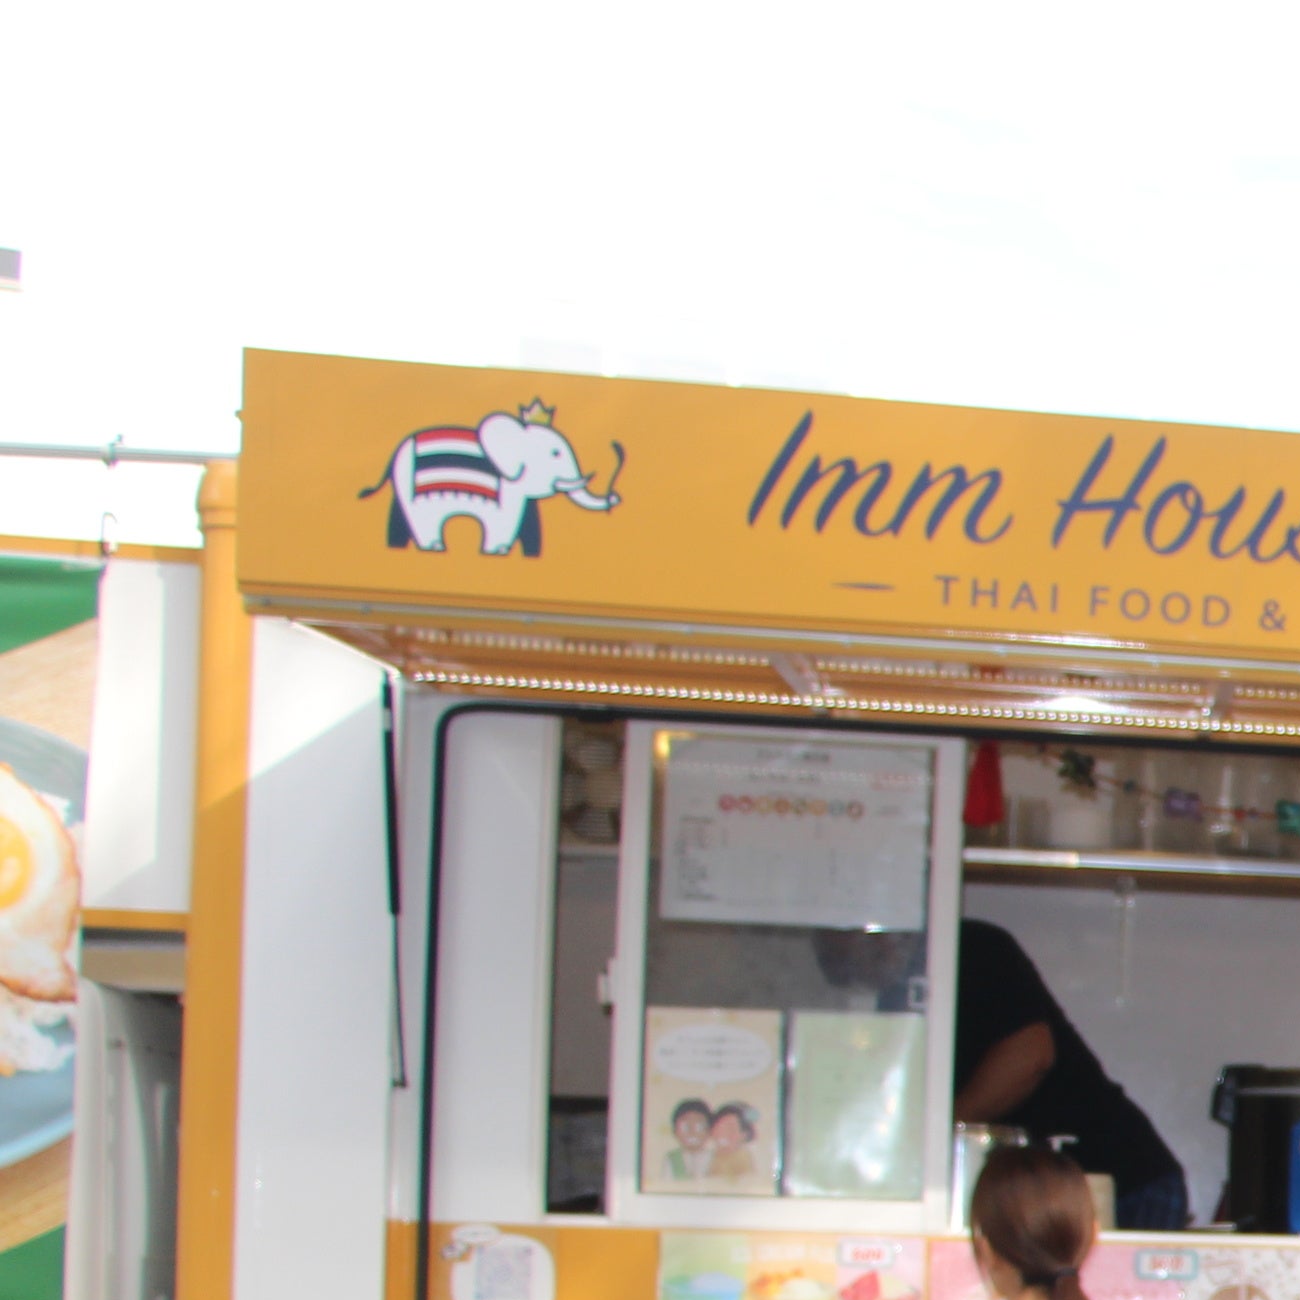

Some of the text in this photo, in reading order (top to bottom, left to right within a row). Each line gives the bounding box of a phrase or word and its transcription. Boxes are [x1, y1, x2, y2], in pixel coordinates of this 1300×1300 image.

[747, 410, 1013, 545] Imm
[934, 574, 1060, 613] THAI
[1089, 585, 1232, 628] FOOD
[1258, 599, 1288, 632] &
